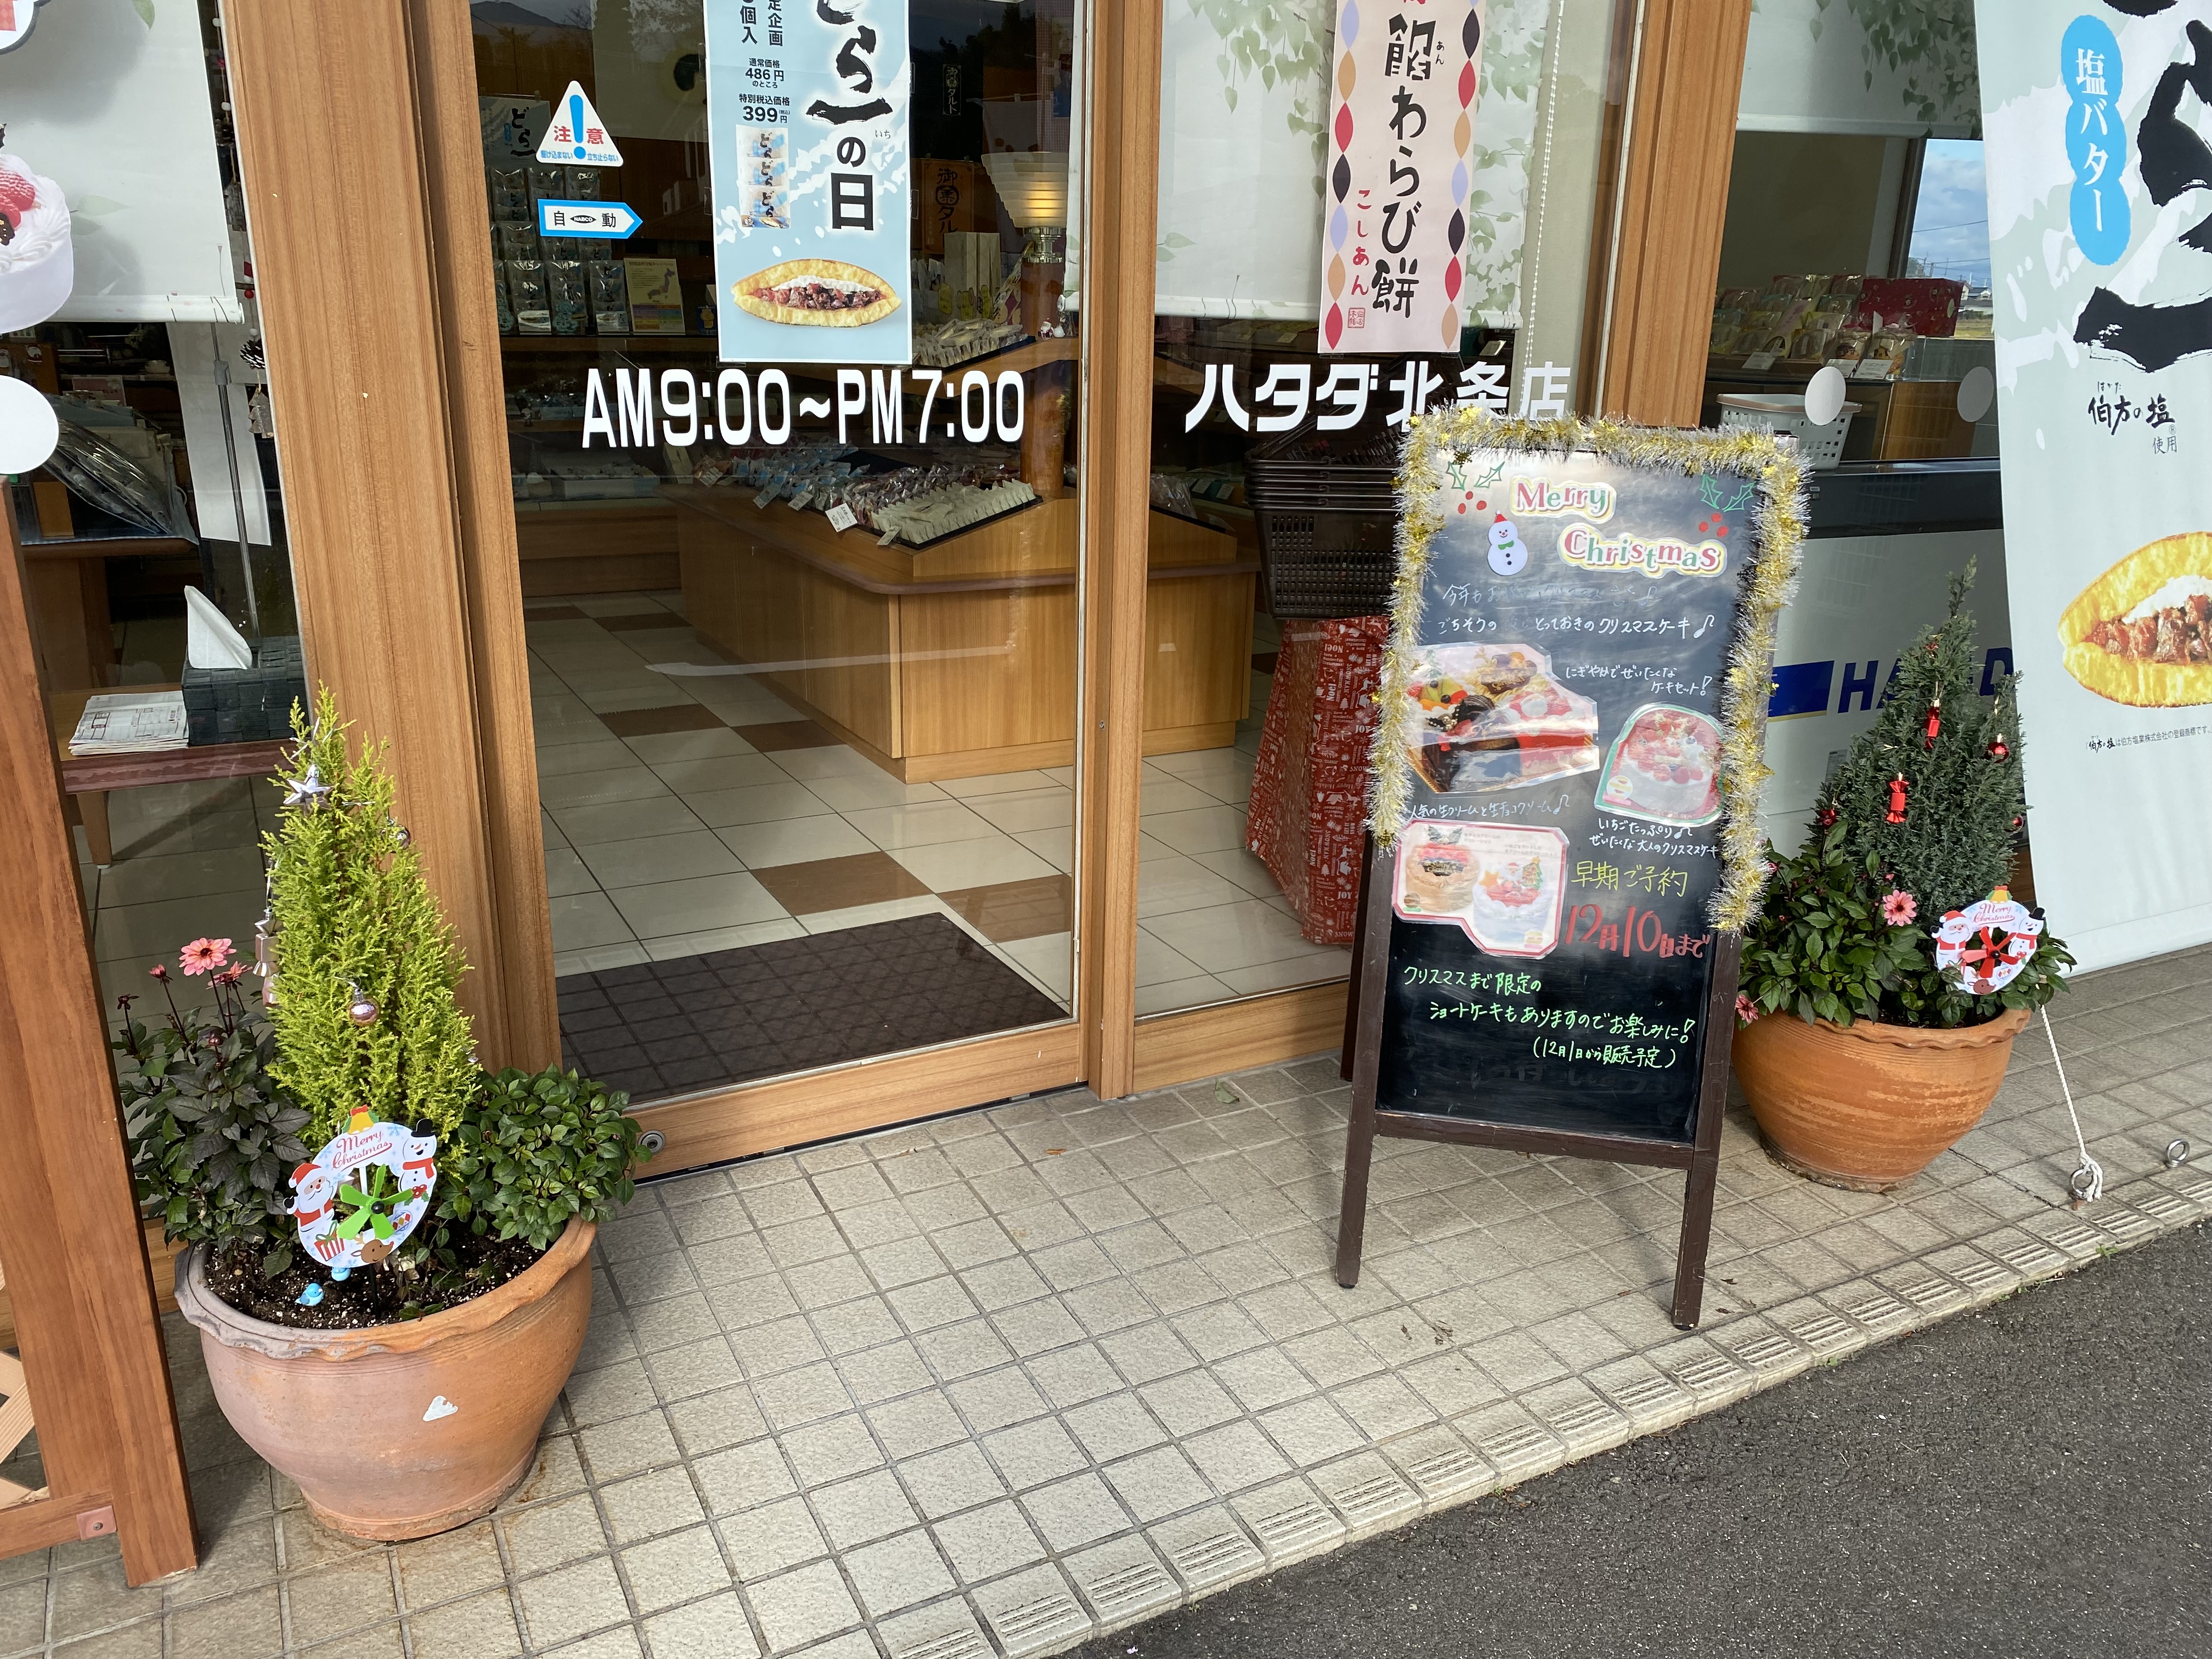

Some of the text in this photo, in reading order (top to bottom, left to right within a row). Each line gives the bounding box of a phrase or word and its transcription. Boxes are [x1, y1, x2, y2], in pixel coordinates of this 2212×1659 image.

[740, 0, 758, 44] 個入
[745, 67, 784, 82] 486円
[749, 58, 780, 69] 通常価格
[752, 81, 778, 89] のところ
[739, 93, 790, 106] 特別税込価格
[875, 129, 891, 139] いち
[2075, 48, 2109, 232] 塩バター
[1372, 13, 1436, 319] 餡わらび餅
[1351, 190, 1372, 295] こしあん
[1185, 361, 1571, 433] ハタダ北条店
[2088, 393, 2175, 436] 伯方の塩
[2152, 436, 2177, 454] 使用
[1517, 482, 1609, 517] Merry
[1565, 530, 1719, 572] Christmas
[1566, 664, 1677, 680] にぎやかでぜいたくな
[1598, 817, 1672, 839] いちごたっぷり
[1571, 860, 1688, 897] 早期ご予約
[1337, 891, 1352, 900] JOY
[1979, 903, 2011, 914] Merry
[1404, 966, 1542, 995] クリスマスまで限定の
[336, 1131, 383, 1154] Merry
[331, 1141, 392, 1171] Christmas
